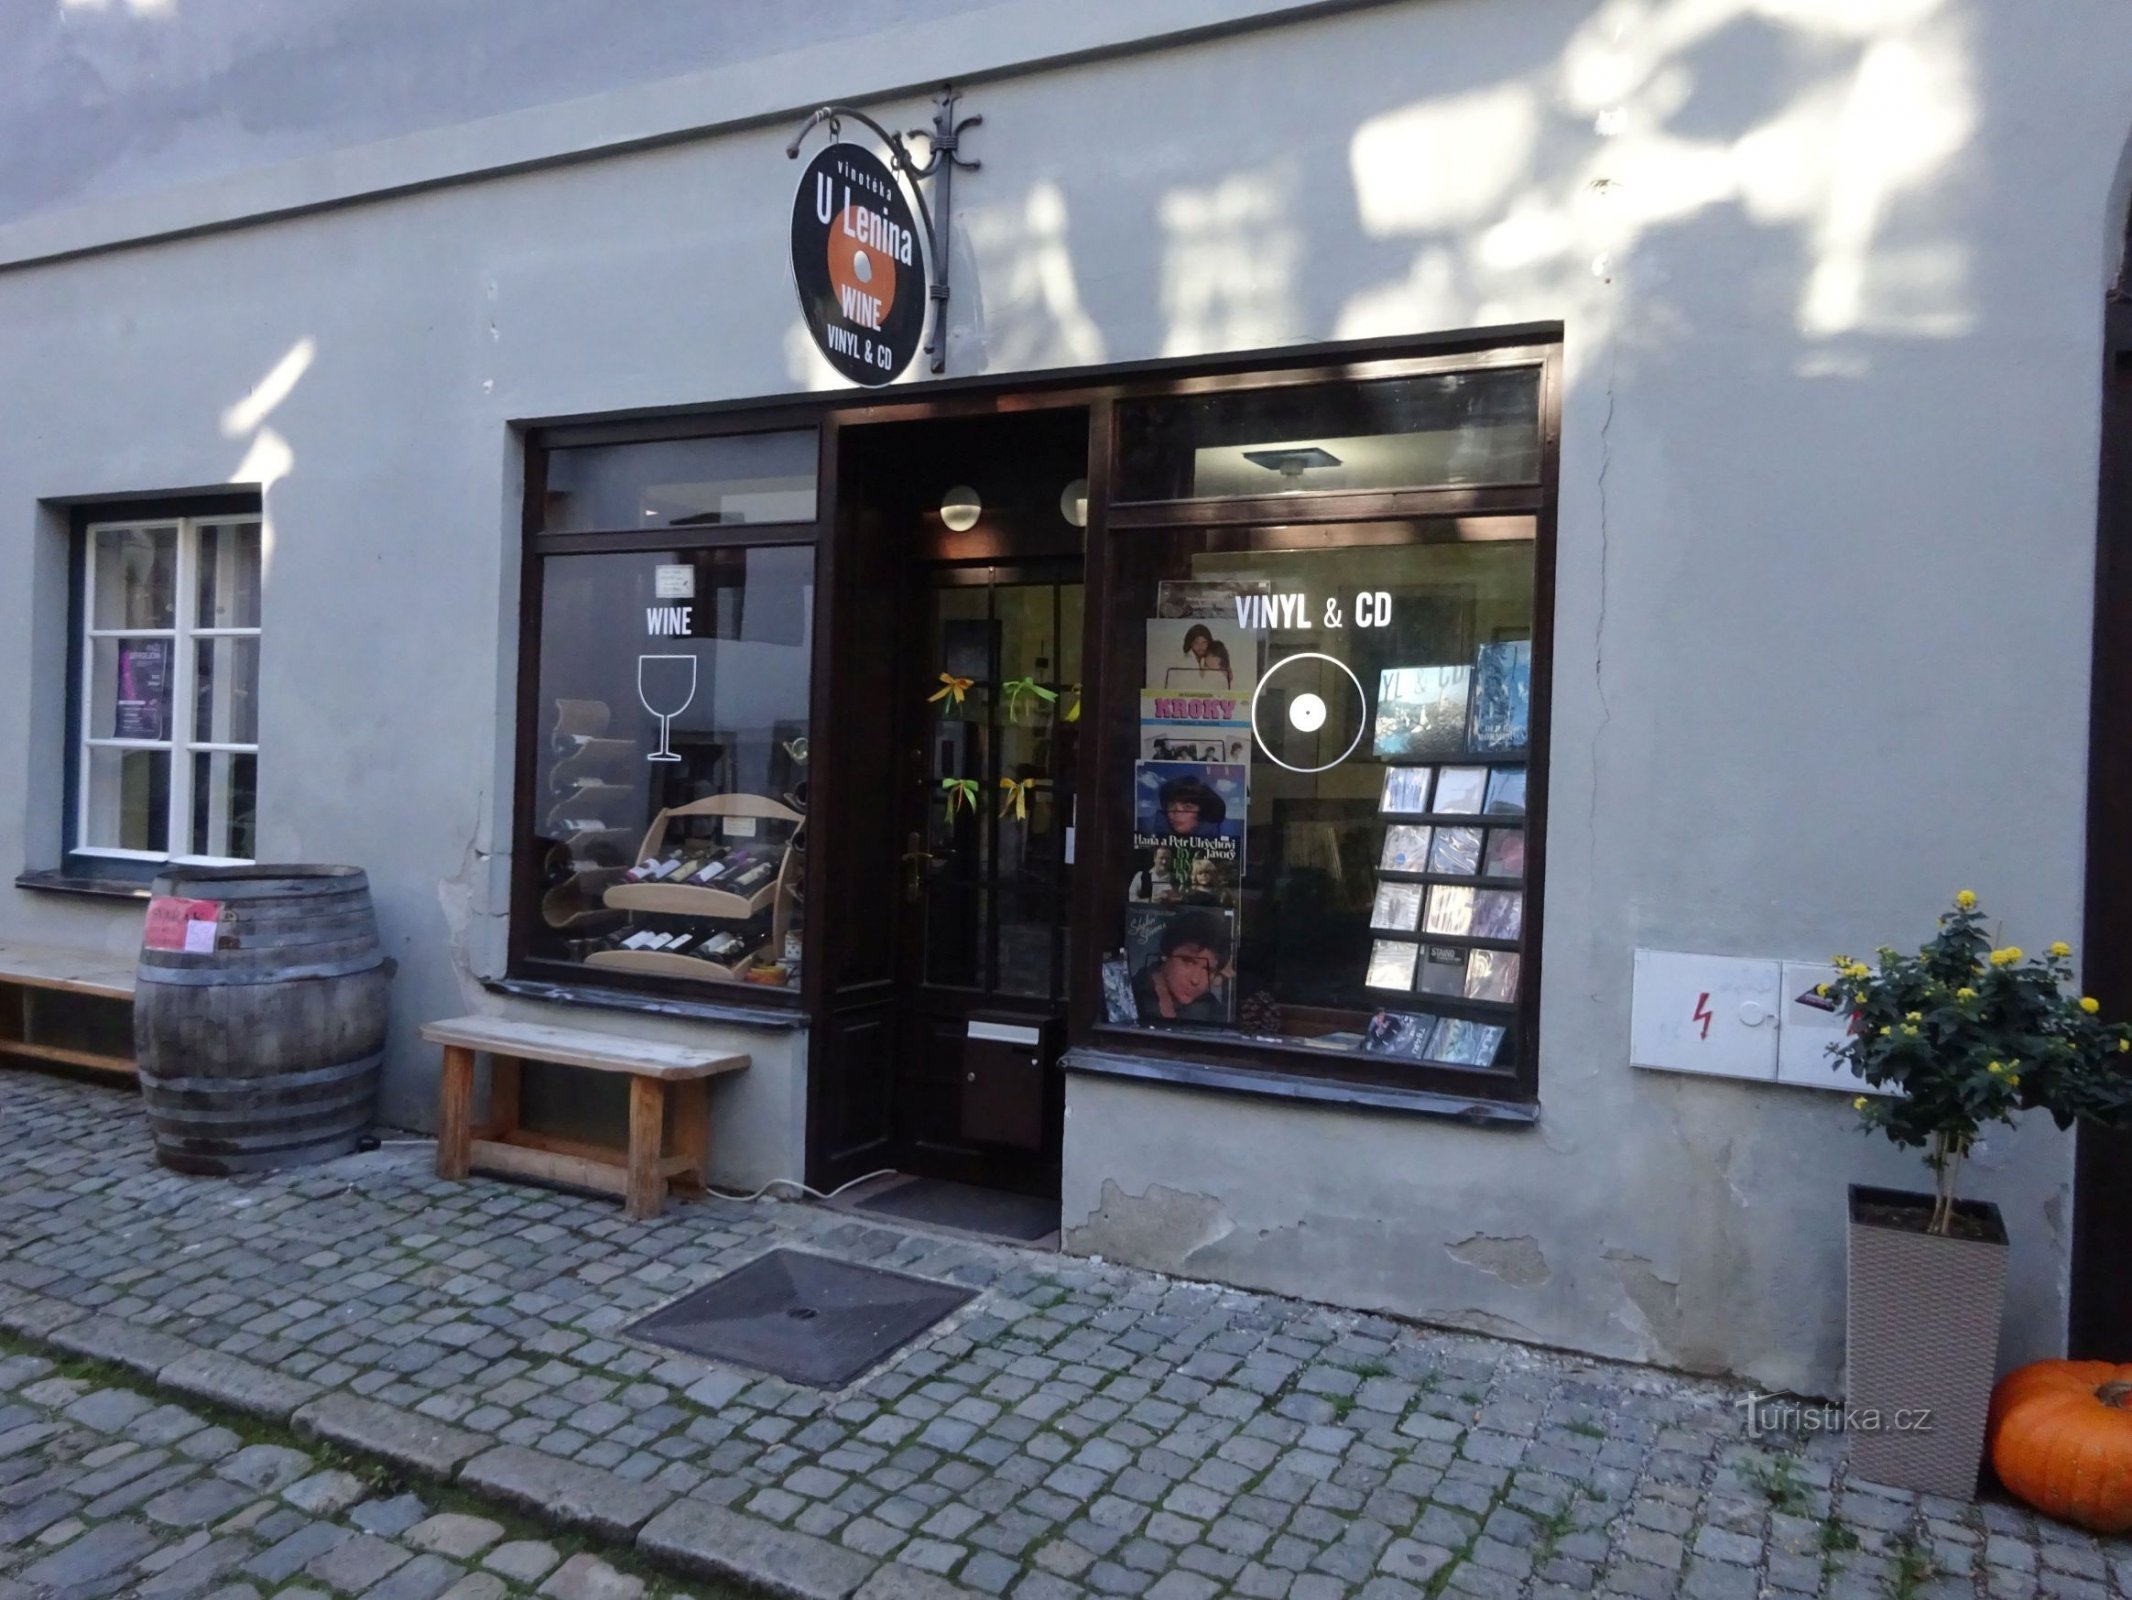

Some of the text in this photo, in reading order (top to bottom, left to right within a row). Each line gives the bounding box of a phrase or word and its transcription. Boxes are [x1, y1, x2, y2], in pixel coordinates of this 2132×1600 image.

[838, 160, 892, 201] vinotéka
[816, 171, 912, 267] U Lenina
[841, 284, 881, 332] WINE
[827, 324, 892, 371] VINYL & CD
[646, 607, 692, 635] WINE
[1235, 591, 1392, 629] VINYL & CD
[1155, 698, 1236, 719] KROKY
[1169, 835, 1188, 848] Petr
